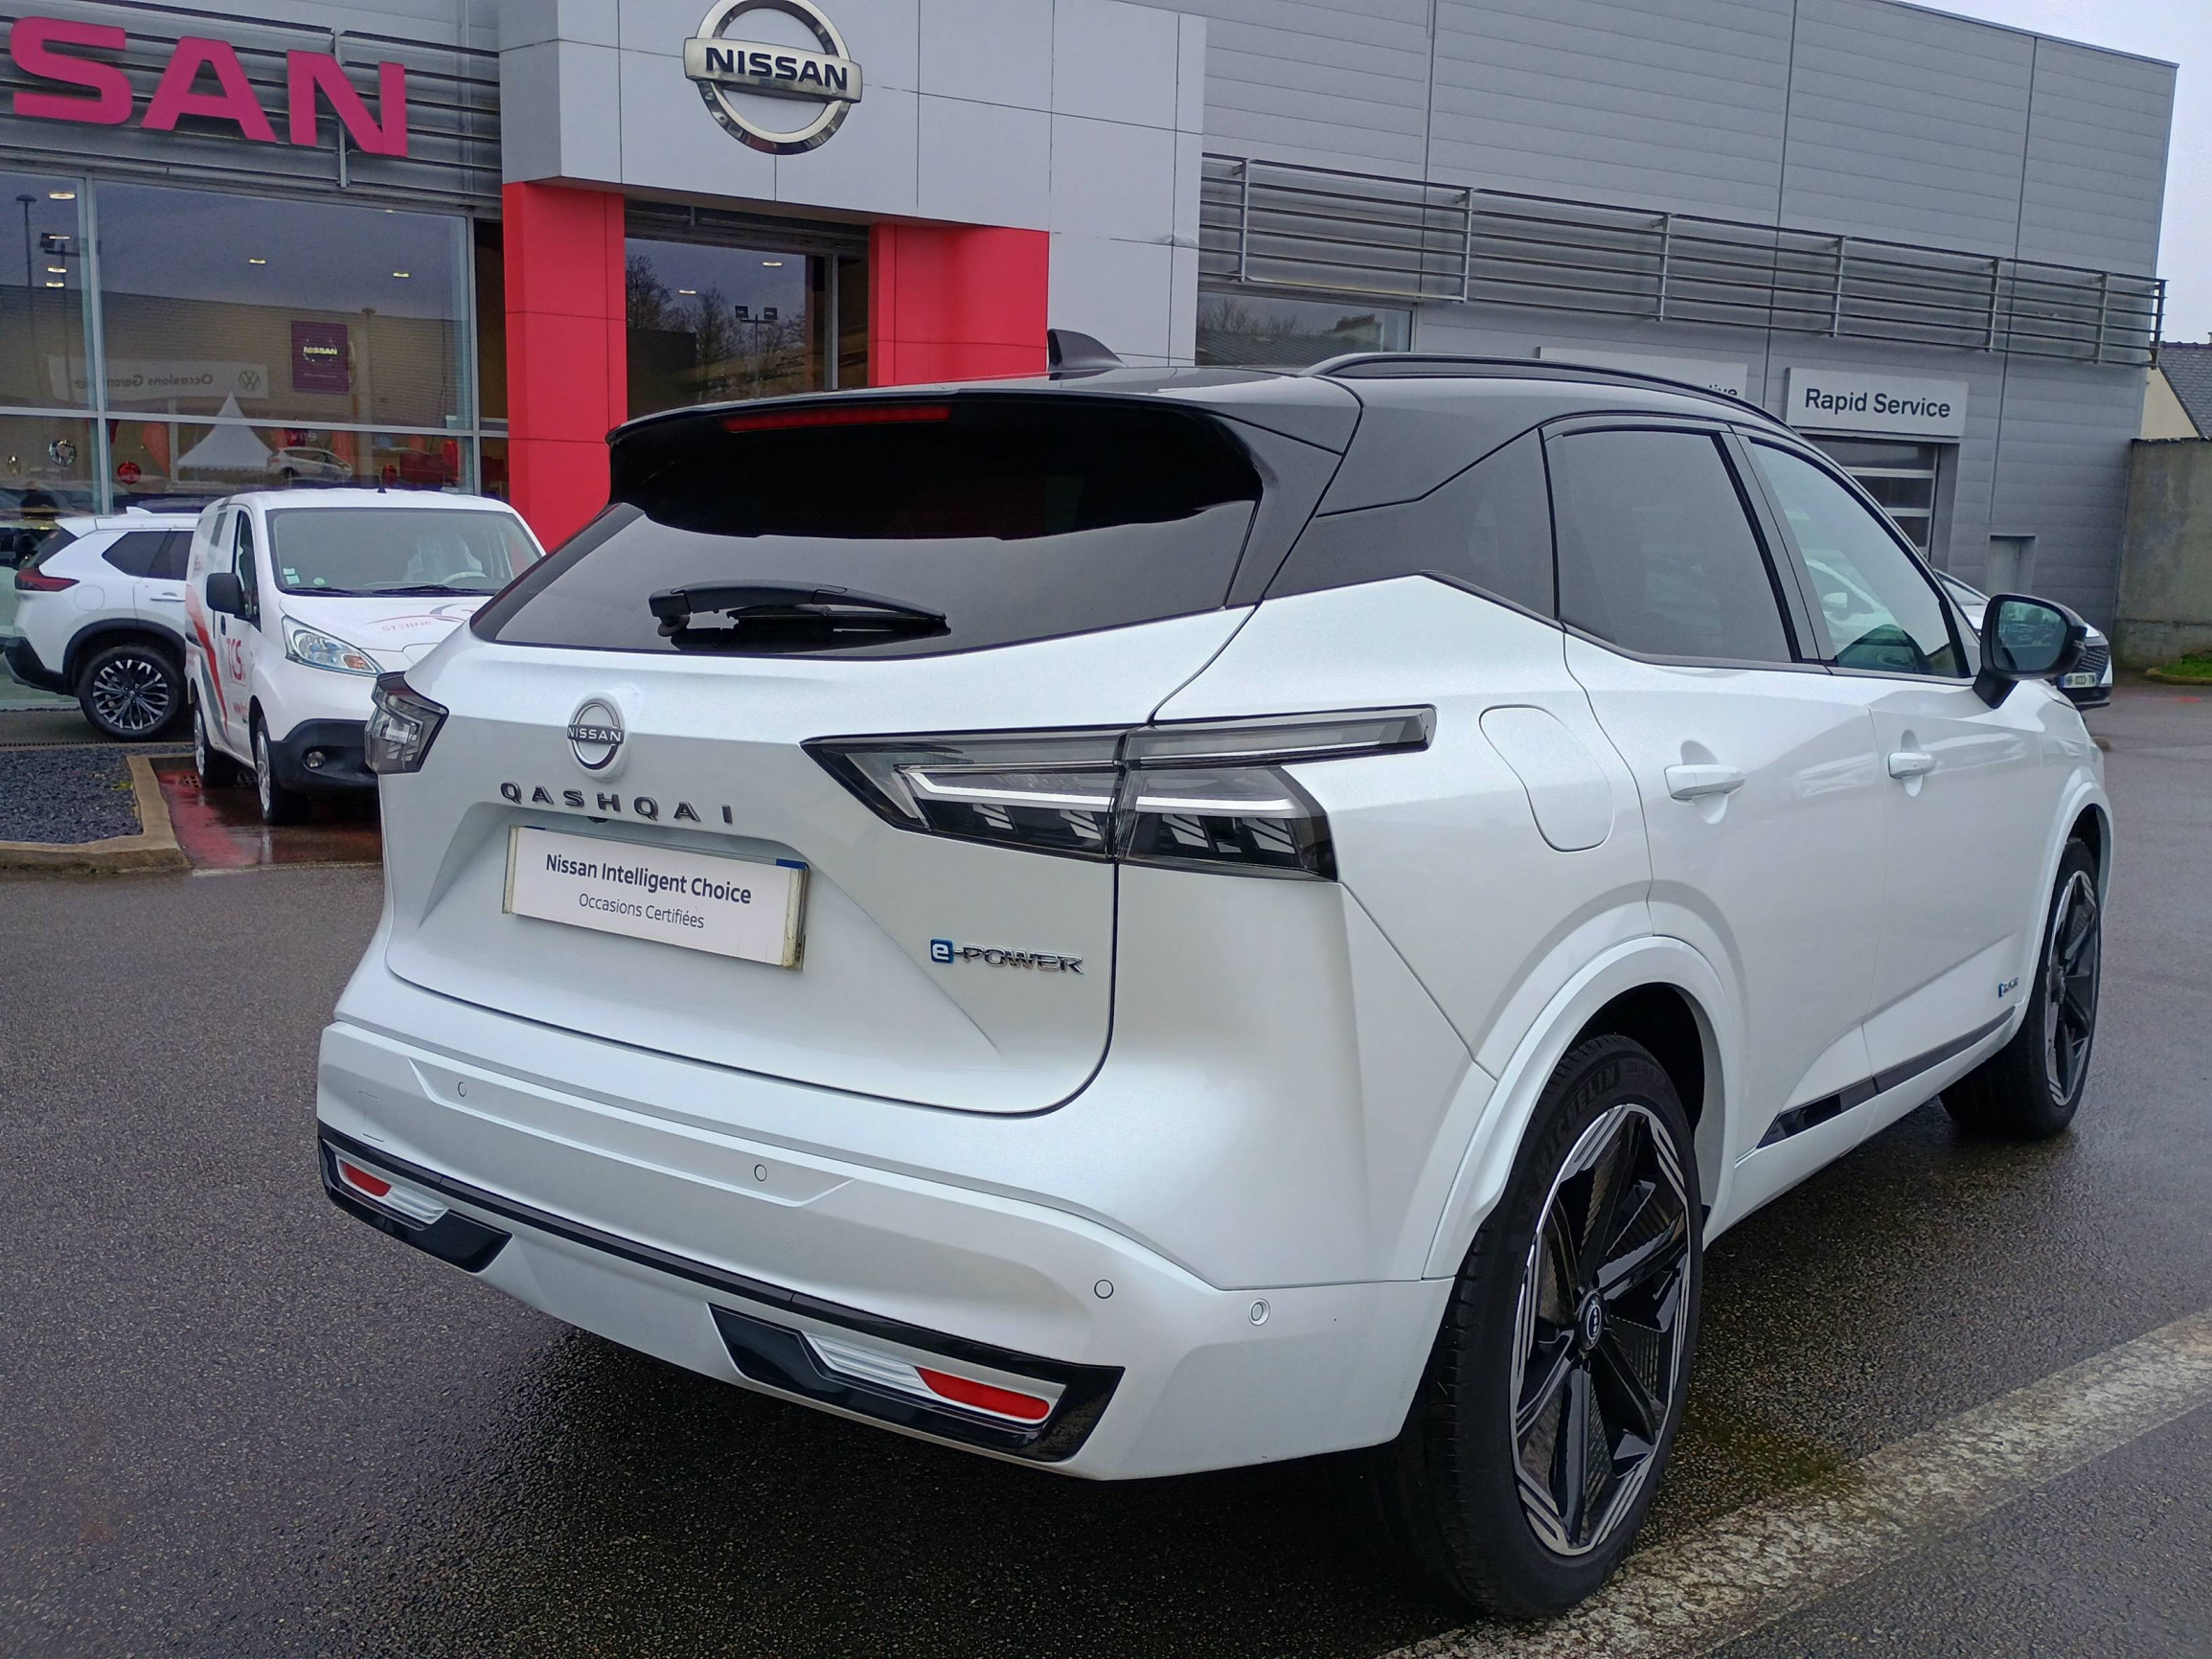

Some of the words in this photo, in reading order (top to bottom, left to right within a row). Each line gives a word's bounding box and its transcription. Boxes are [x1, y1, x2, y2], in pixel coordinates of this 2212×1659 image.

[10, 15, 409, 157] SAN
[705, 47, 848, 91] NISSAN
[303, 346, 338, 355] NISSAN
[1805, 388, 1867, 415] Rapid
[1873, 393, 1950, 418] Service
[568, 727, 622, 741] NISSAN
[500, 782, 733, 824] QASHQAI
[545, 853, 597, 878] Nissan
[602, 862, 687, 893] Intelligent
[691, 877, 752, 904] Choice
[579, 893, 642, 918] Occasions
[646, 904, 705, 929] Certifiées
[931, 940, 1083, 975] e-POWER
